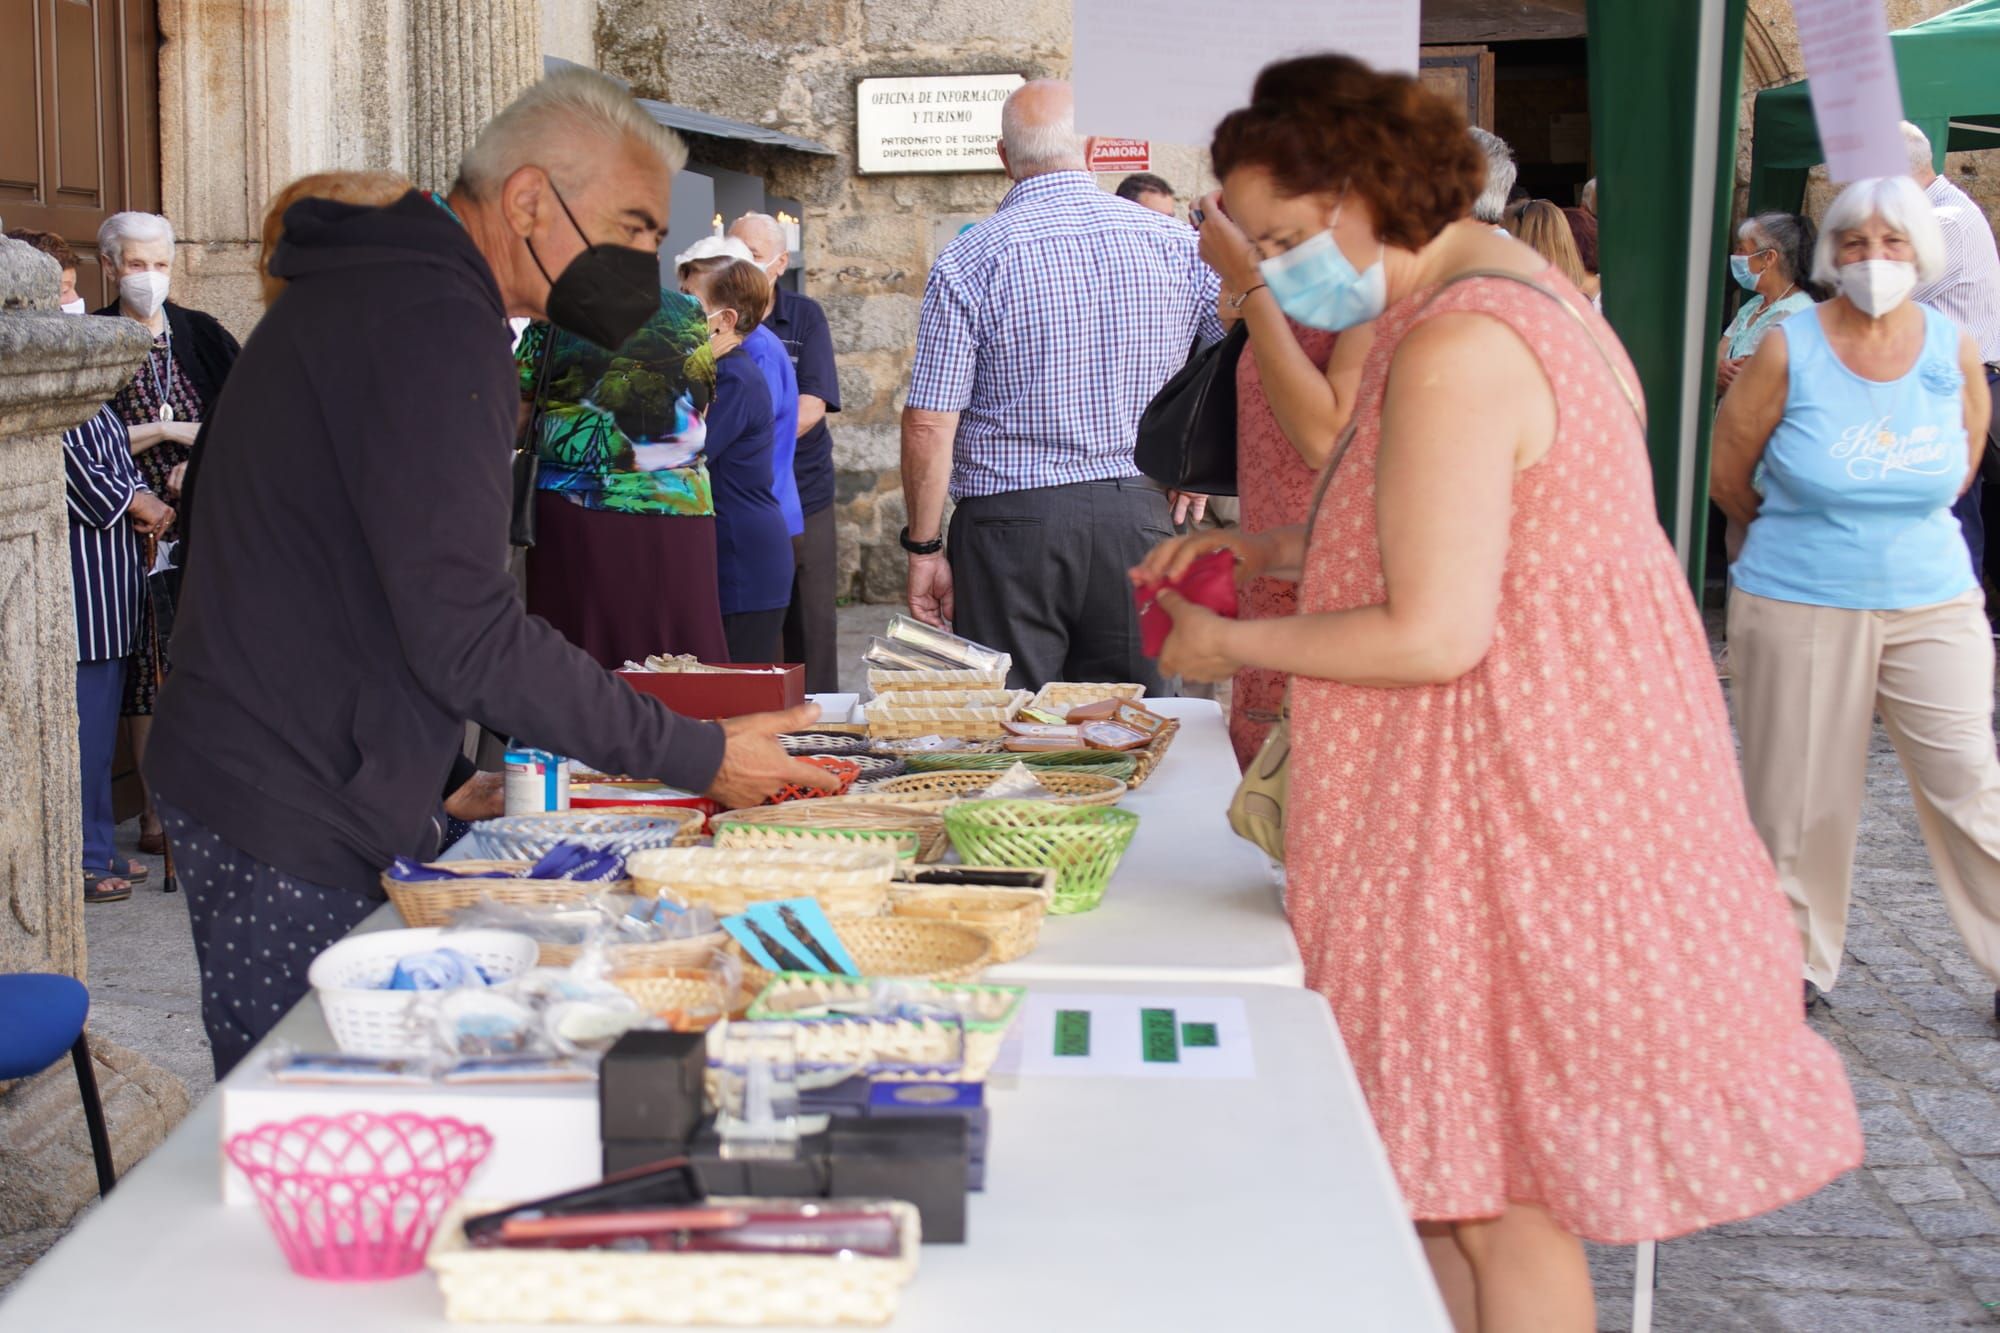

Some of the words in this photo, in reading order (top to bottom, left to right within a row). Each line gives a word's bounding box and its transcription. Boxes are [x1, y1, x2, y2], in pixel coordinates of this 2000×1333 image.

[871, 92, 915, 105] OFICINA
[919, 91, 933, 104] DE
[912, 111, 921, 124] Y
[923, 110, 973, 123] TURISMO
[881, 136, 942, 146] PATRONATO
[945, 136, 959, 144] DE
[882, 148, 942, 158] DIPUTACION
[945, 147, 959, 157] DE
[962, 146, 998, 157] ZAMOR
[1093, 146, 1147, 157] ZAMORA
